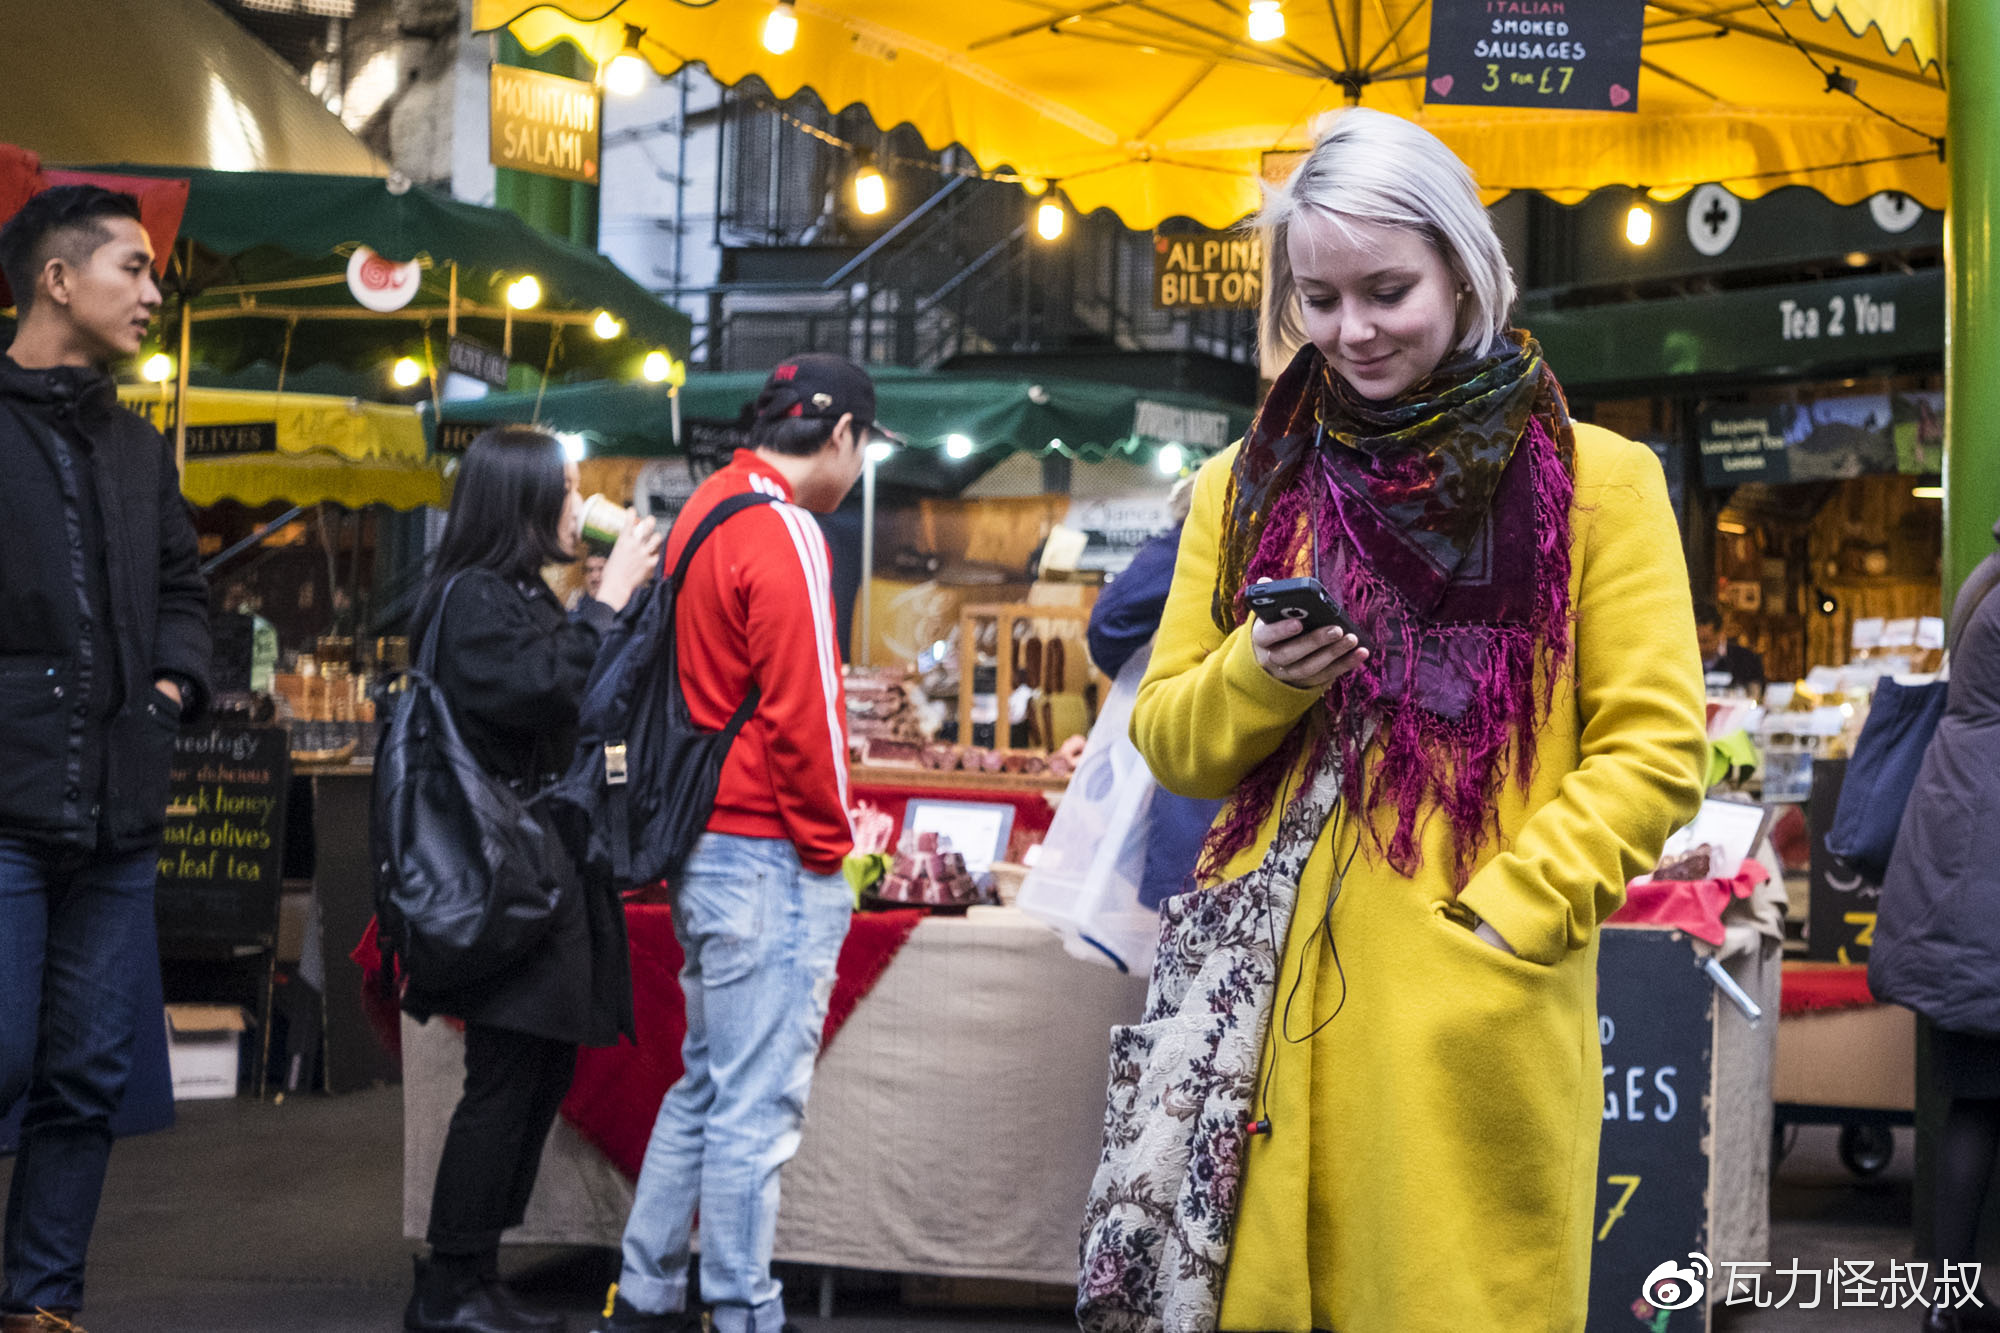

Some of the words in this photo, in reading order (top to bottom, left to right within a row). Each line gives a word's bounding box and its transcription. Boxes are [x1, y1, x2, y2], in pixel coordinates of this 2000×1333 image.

[1486, 0, 1566, 14] ITALIAN
[1491, 18, 1570, 37] SMOKED
[1474, 39, 1587, 61] SAUSAGES
[1481, 63, 1500, 93] 3
[495, 75, 595, 133] MOUNTAIN
[503, 120, 582, 172] SALAMI
[1779, 299, 1820, 341] Tea
[1827, 295, 1846, 337] 2
[1853, 292, 1896, 335] You
[187, 427, 263, 452] OLIVES
[215, 785, 276, 827] honey
[209, 818, 271, 849] olives
[177, 849, 218, 881] leaf
[227, 854, 261, 882] tea
[1597, 1174, 1642, 1242] 7
